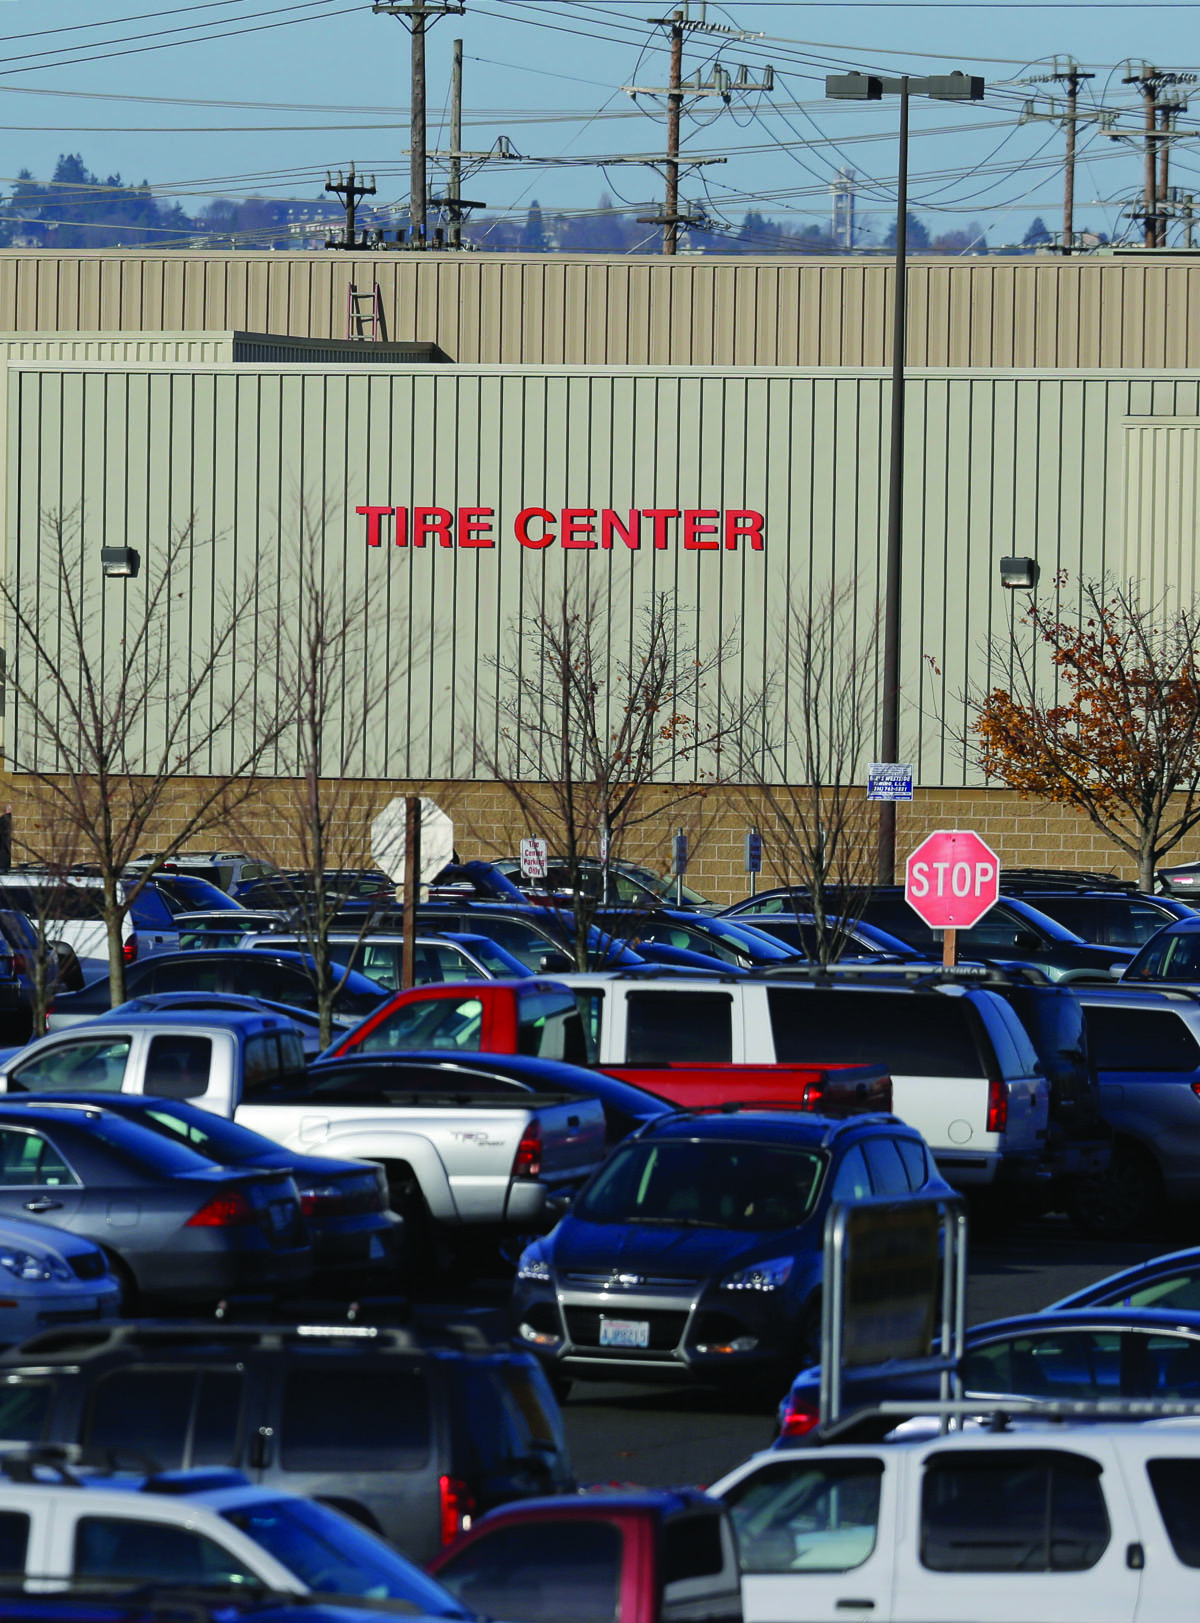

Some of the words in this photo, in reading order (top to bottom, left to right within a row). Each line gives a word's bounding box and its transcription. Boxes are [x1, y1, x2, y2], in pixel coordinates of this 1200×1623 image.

[356, 506, 494, 549] TIRE
[514, 507, 764, 551] CENTER
[525, 849, 544, 857] Cener
[528, 867, 540, 875] Only
[910, 862, 994, 897] STOP
